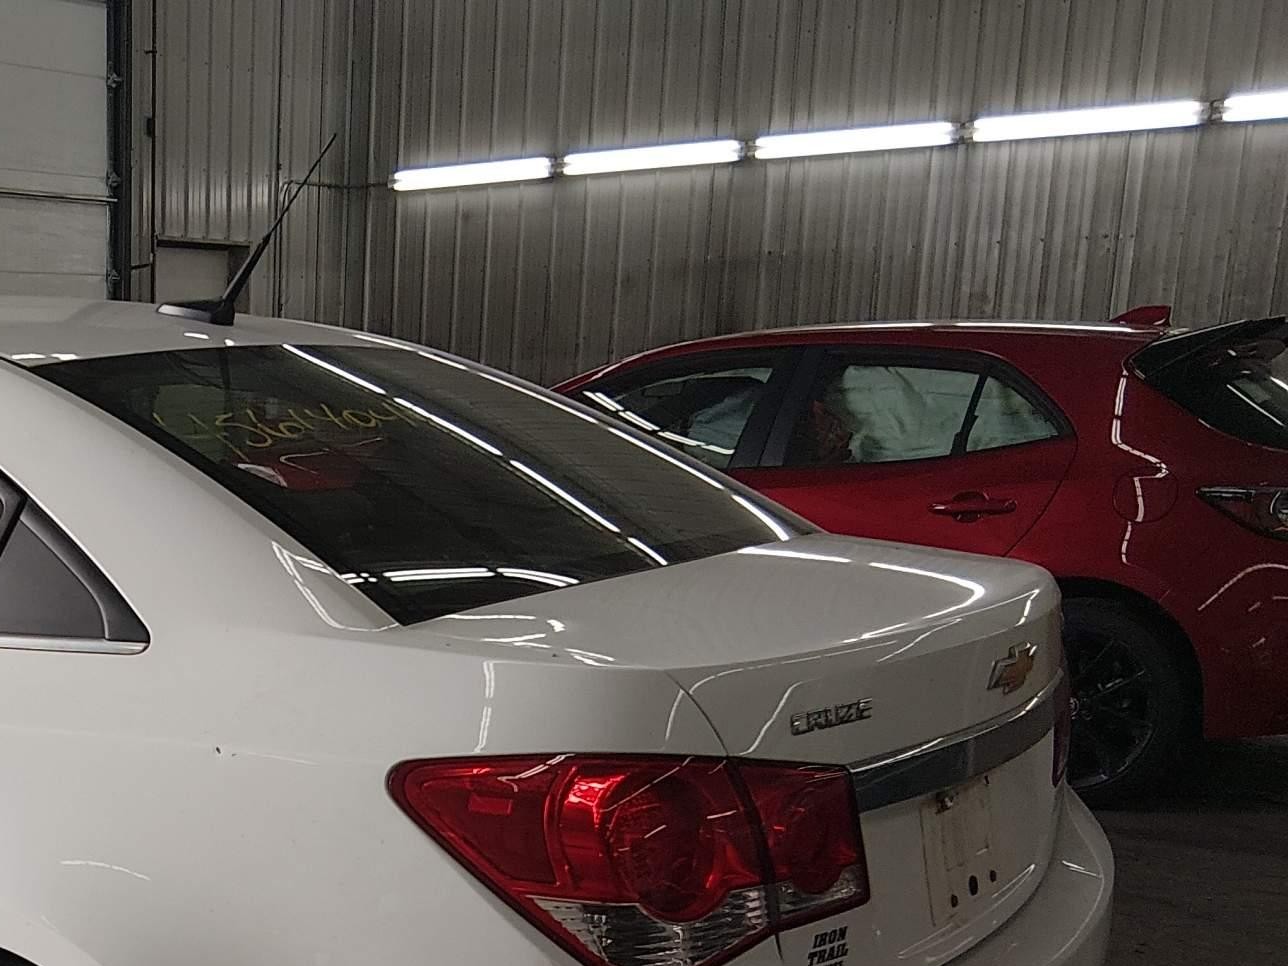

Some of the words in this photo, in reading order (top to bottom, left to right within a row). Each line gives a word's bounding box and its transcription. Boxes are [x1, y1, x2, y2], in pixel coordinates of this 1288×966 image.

[790, 697, 873, 737] CRUZE
[813, 925, 849, 949] IRON
[807, 942, 850, 966] TRAIL
